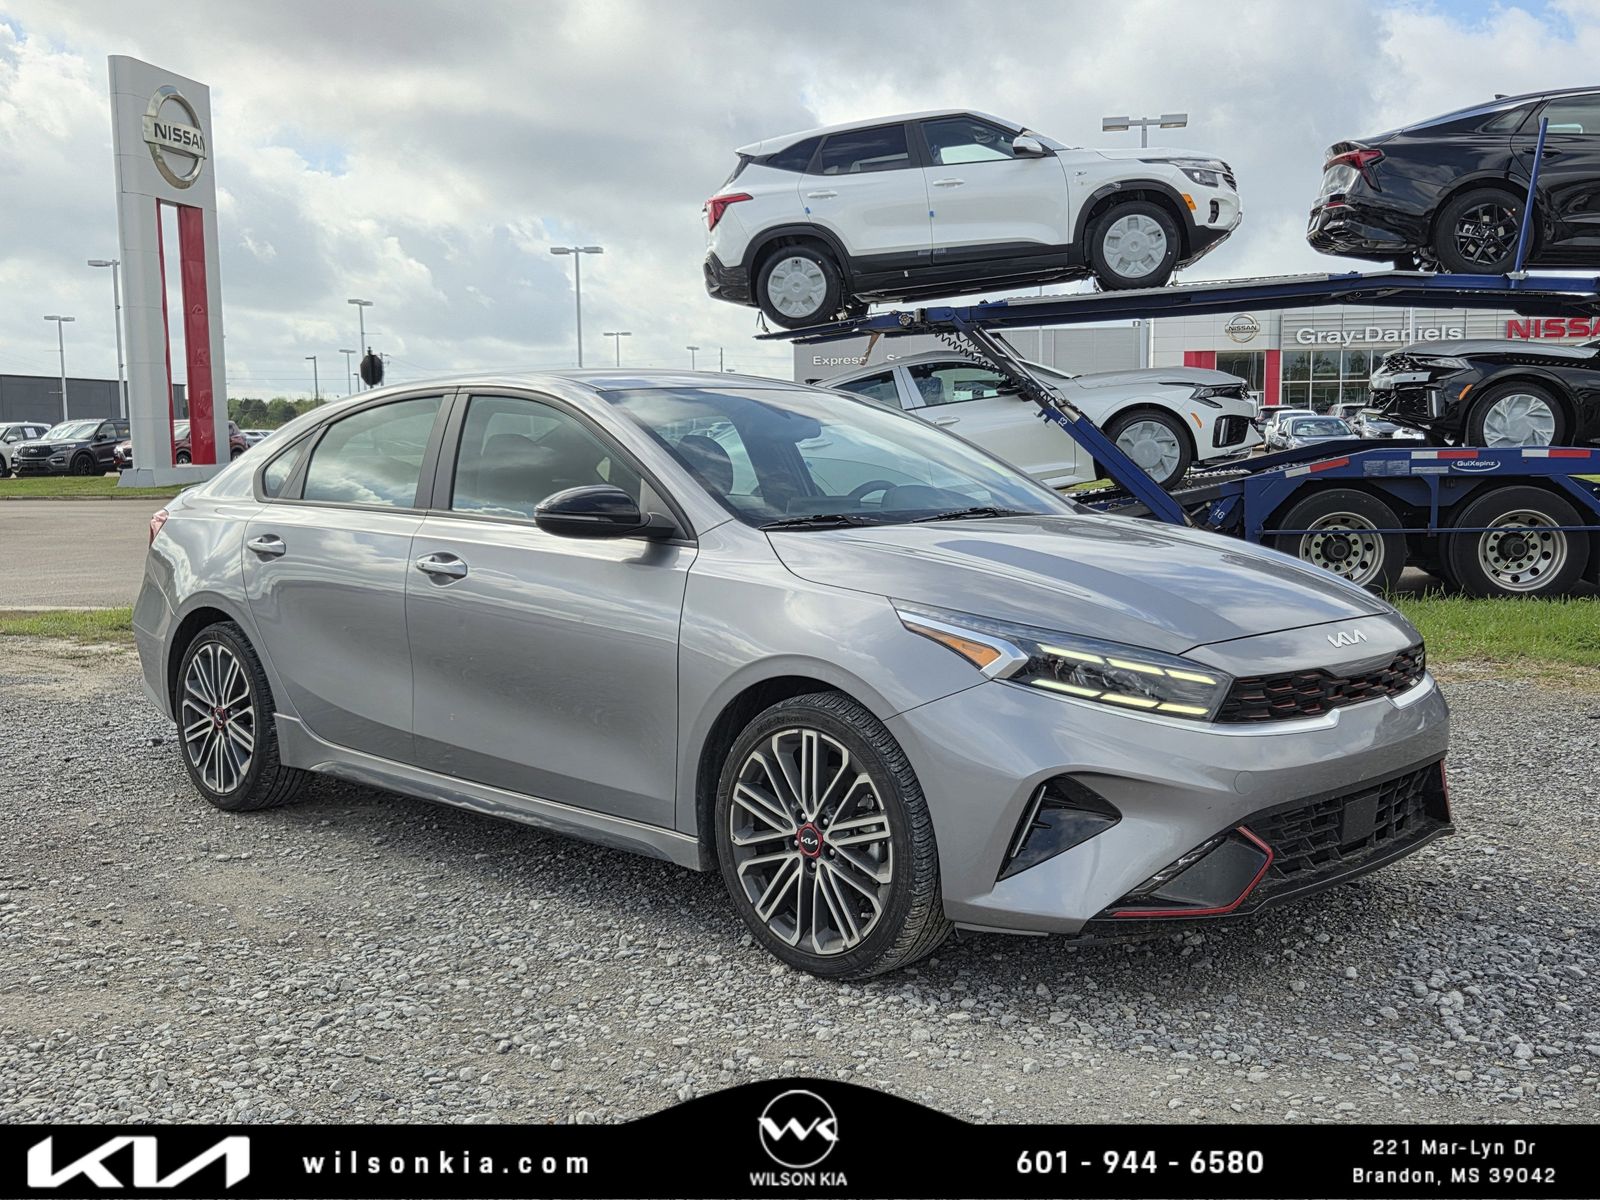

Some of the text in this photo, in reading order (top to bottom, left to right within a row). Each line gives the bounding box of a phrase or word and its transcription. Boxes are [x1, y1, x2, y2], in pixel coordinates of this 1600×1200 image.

[153, 122, 206, 152] NISSAN
[1296, 324, 1464, 347] Gray-Daniels
[1057, 417, 1068, 427] 13
[1215, 509, 1225, 520] 16
